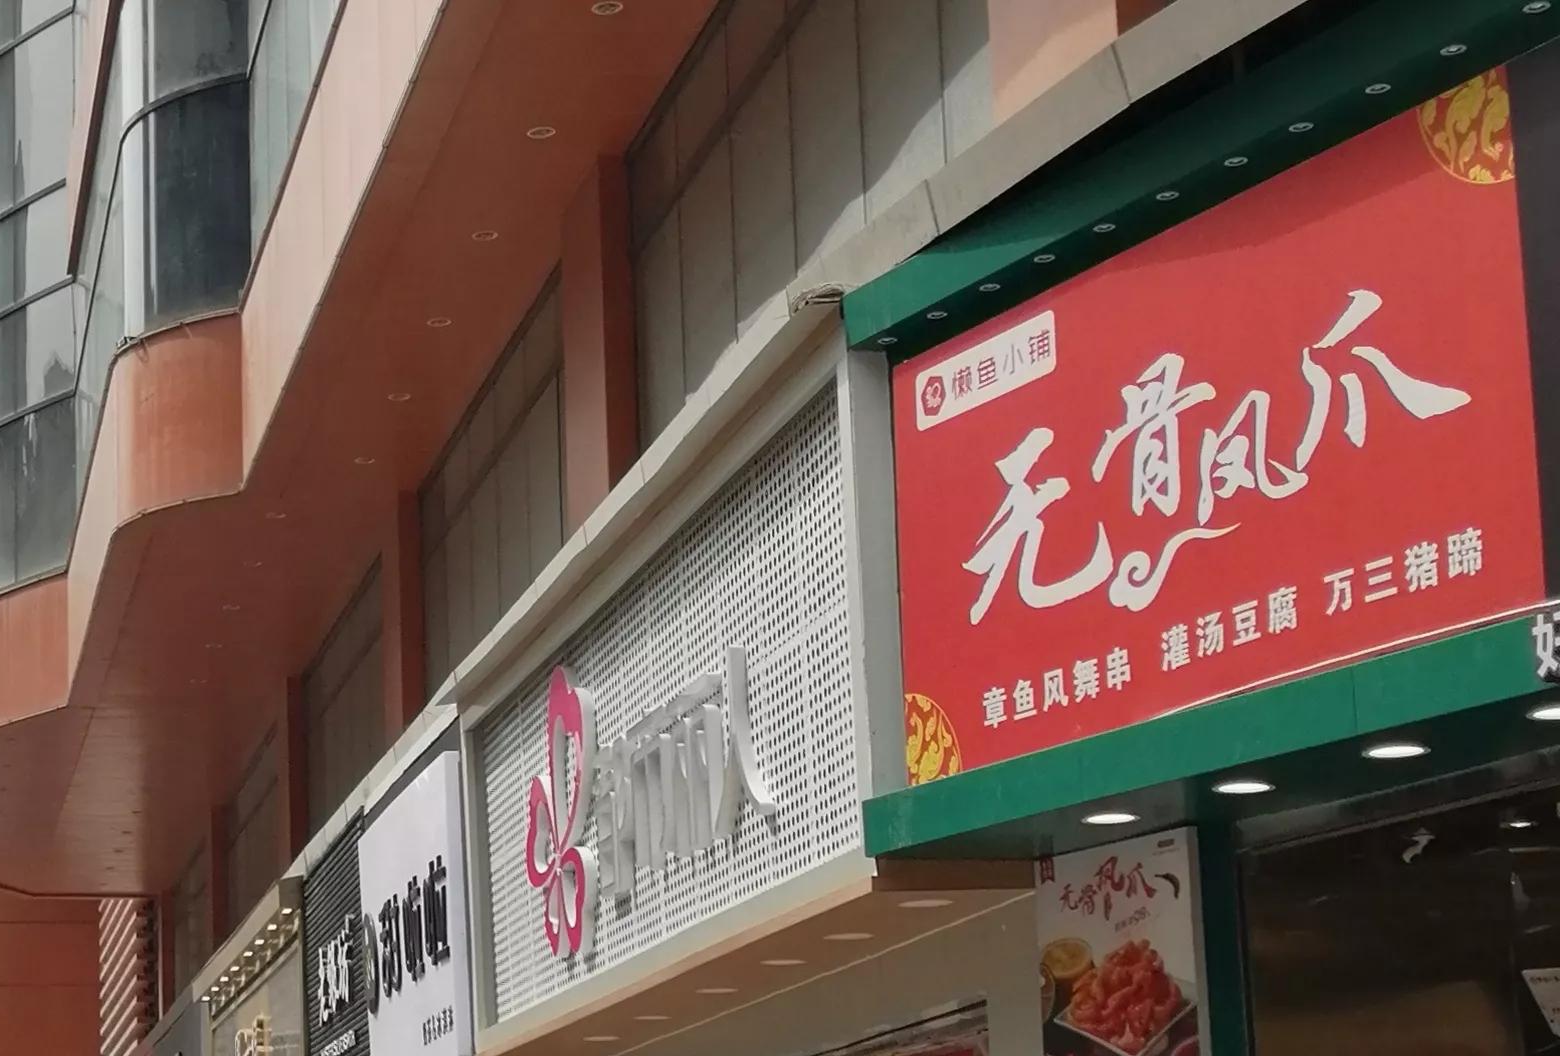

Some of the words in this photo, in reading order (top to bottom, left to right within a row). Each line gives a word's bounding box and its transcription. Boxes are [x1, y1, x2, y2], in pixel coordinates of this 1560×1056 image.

[951, 329, 1051, 401] 懒鱼小铺
[962, 289, 1471, 624] 无骨凤爪
[1160, 586, 1300, 671] 灌汤豆腐
[1324, 527, 1484, 617] 万三猪蹄
